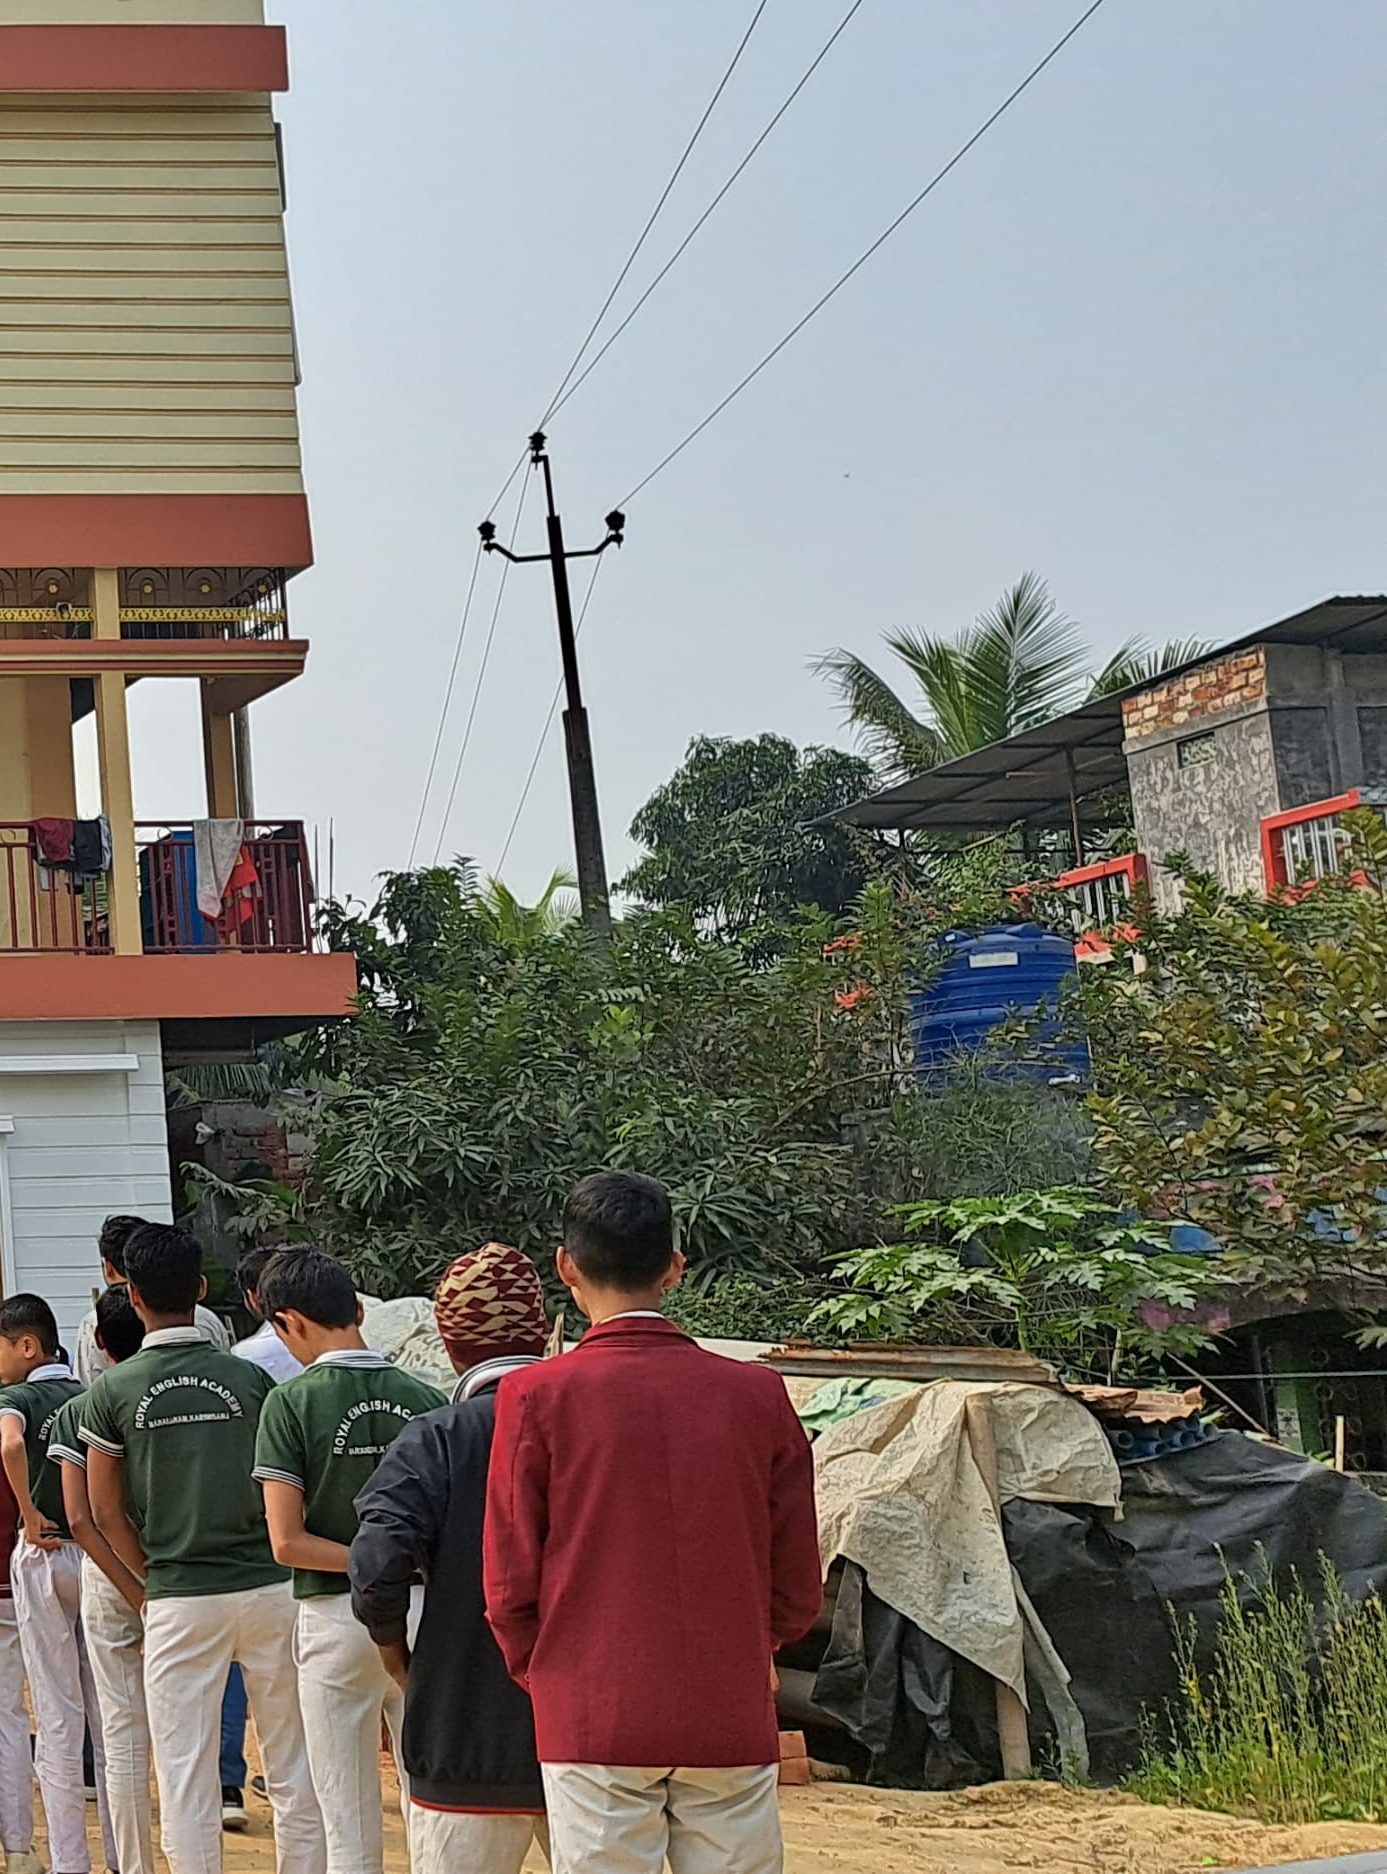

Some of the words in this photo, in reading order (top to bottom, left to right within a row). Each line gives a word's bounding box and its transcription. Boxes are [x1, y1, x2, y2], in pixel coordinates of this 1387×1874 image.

[135, 1395, 153, 1429] ROYAL
[150, 1376, 198, 1396] ENGLISH
[200, 1378, 244, 1417] ACADEMY
[333, 1417, 352, 1455] ROYAL
